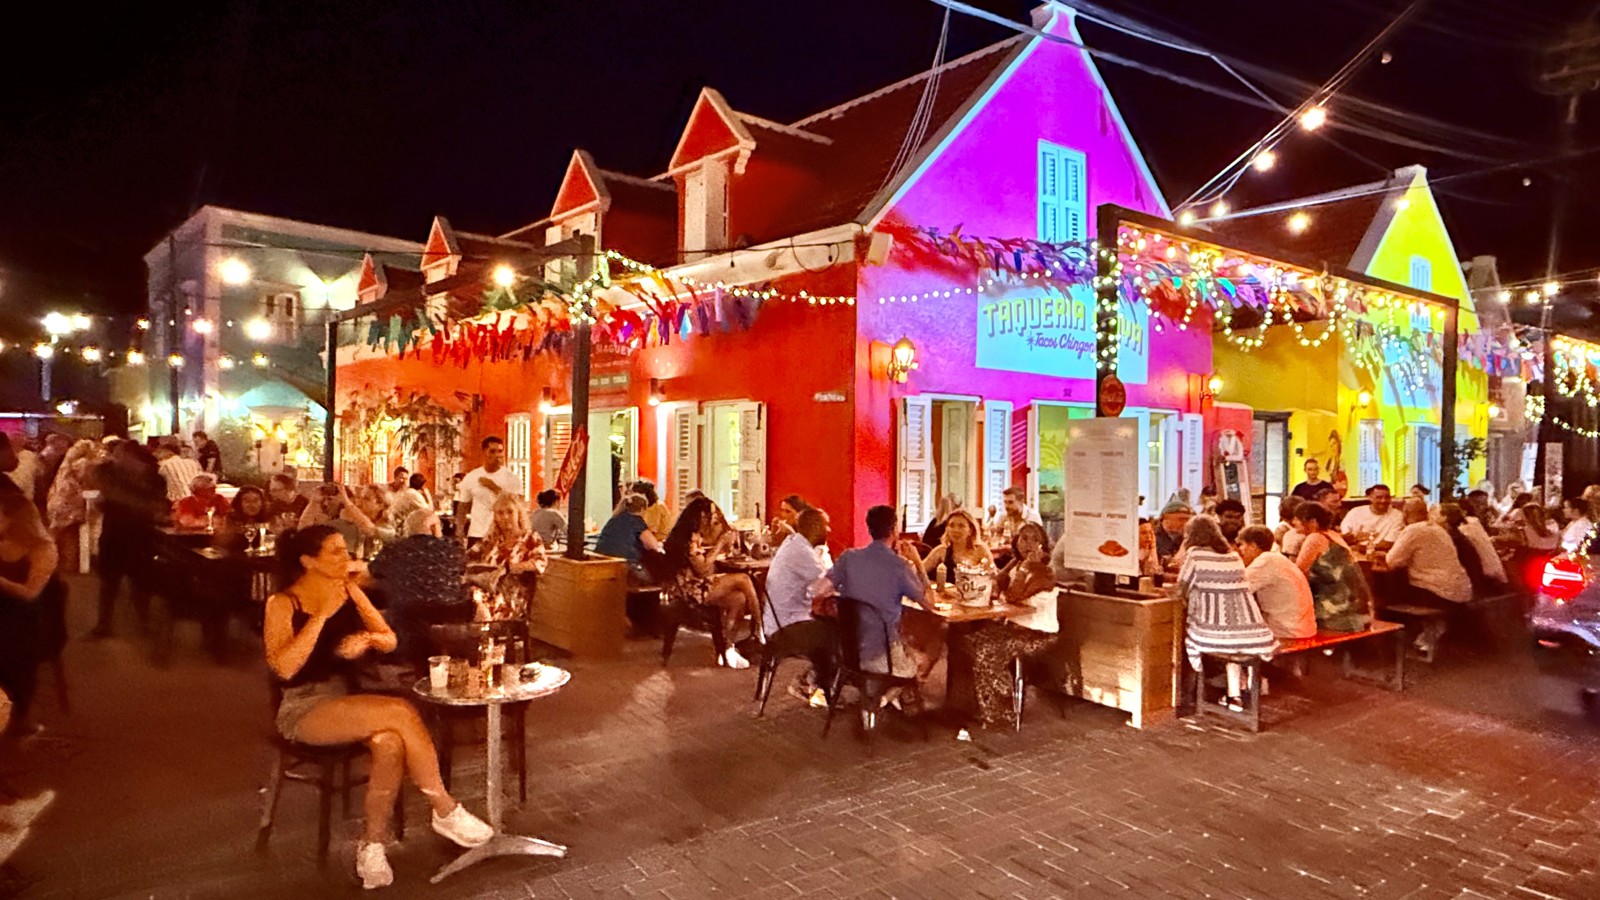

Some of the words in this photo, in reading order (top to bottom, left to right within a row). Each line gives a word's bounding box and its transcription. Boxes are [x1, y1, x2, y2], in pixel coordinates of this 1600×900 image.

[983, 298, 1085, 337] TAQUERIA
[1035, 332, 1057, 349] Tacos
[1059, 333, 1096, 360] Chingon
